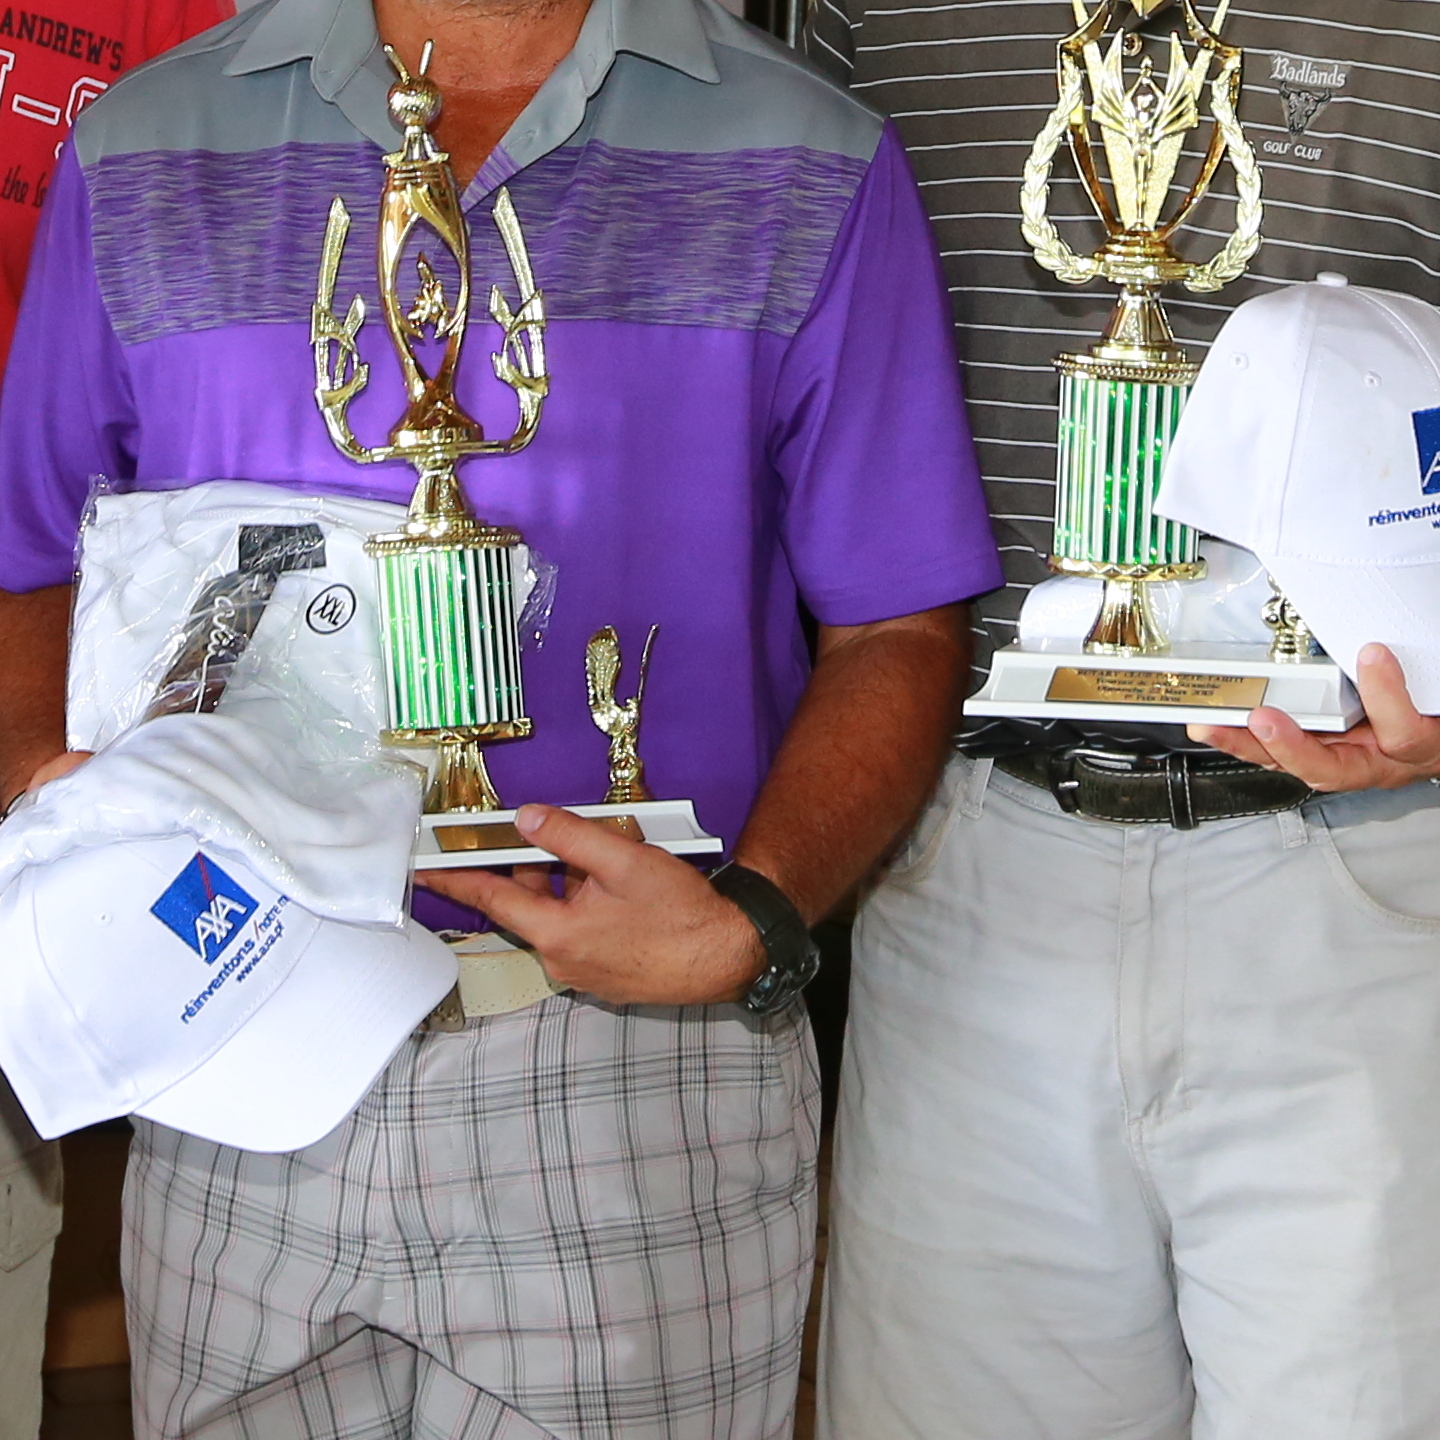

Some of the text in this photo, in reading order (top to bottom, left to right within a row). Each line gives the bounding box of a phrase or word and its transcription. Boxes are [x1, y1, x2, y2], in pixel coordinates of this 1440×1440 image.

[1269, 56, 1348, 88] Badlands
[1263, 140, 1323, 161] GOLF CLUB
[0, 164, 30, 205] the
[313, 593, 347, 627] XXL
[194, 893, 248, 959] AXA
[180, 937, 255, 1025] réinventons
